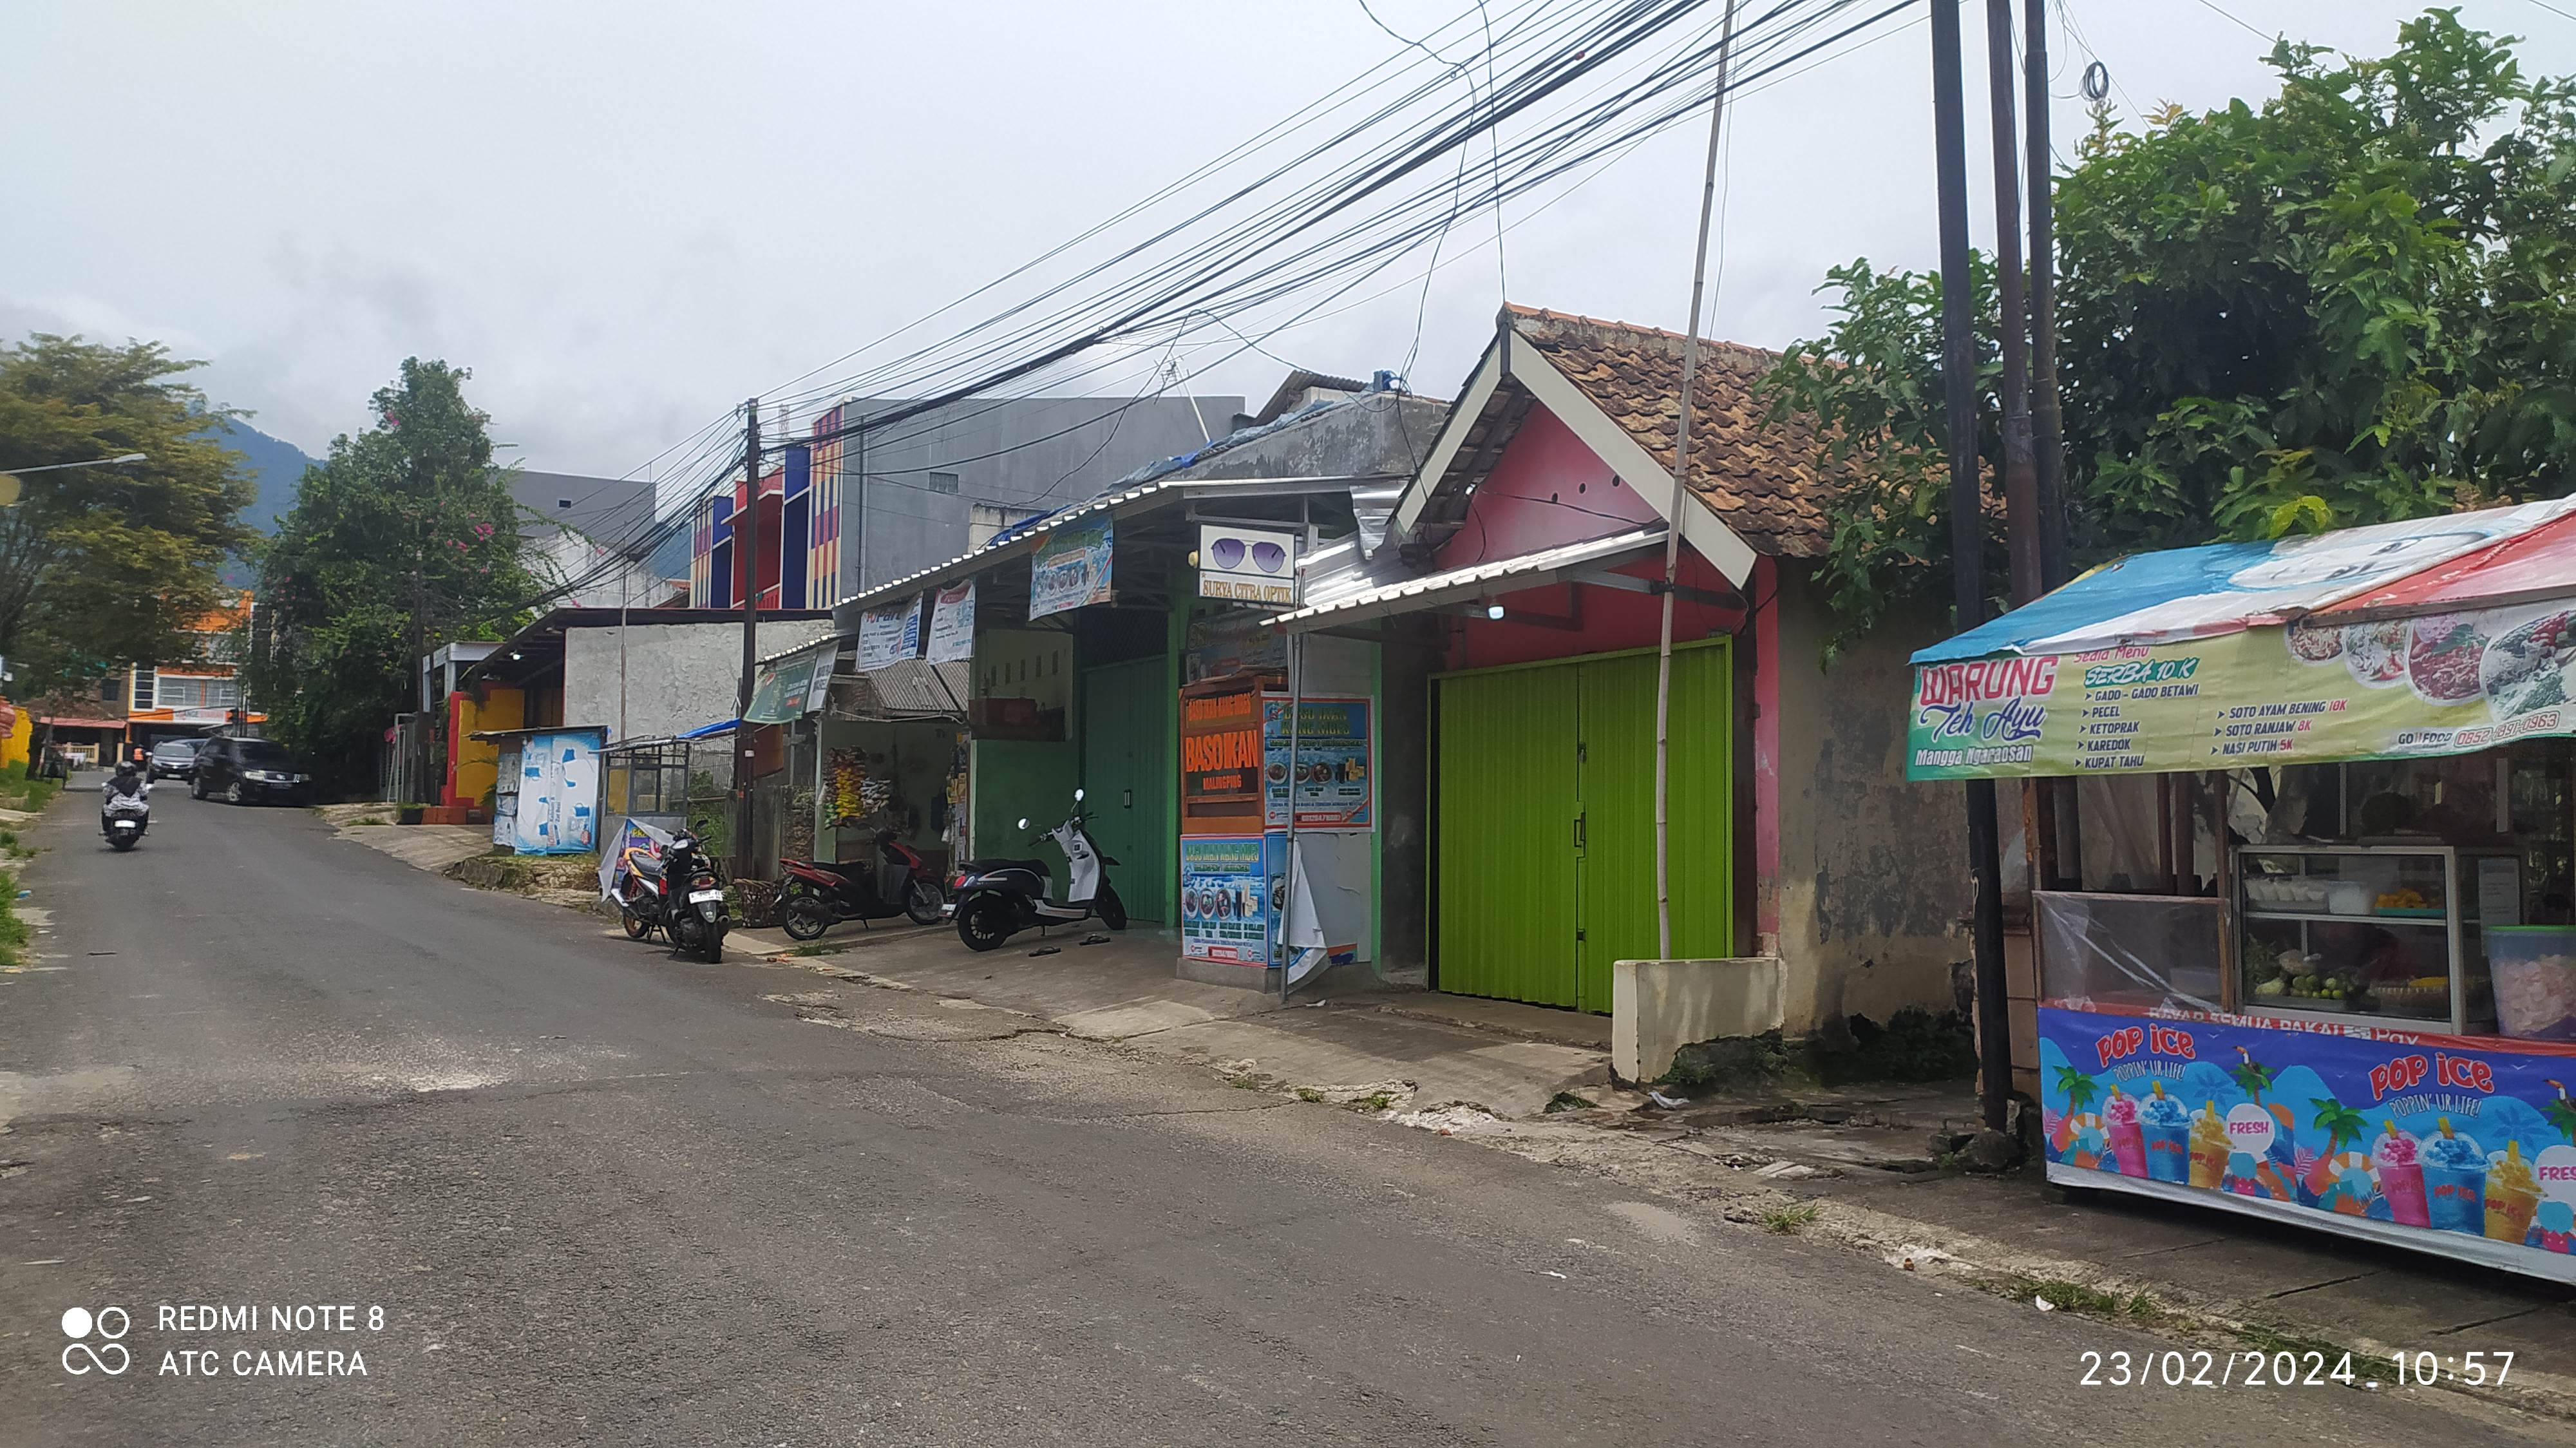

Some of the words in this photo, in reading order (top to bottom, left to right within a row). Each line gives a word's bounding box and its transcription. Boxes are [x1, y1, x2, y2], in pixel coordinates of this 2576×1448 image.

[1202, 580, 1233, 597] SURYA
[1234, 582, 1262, 600] CITRA
[1264, 586, 1292, 604] OPTIK
[2115, 646, 2150, 659] Menu
[2084, 659, 2155, 686] SERBA
[2154, 662, 2175, 681] 10
[2177, 658, 2197, 678] K
[1919, 656, 2060, 707] WARUNG
[2094, 690, 2121, 701] GADO
[2131, 687, 2159, 700] GADO
[2160, 683, 2199, 698] BETAWI
[1283, 707, 1314, 720] BSO
[1919, 701, 1975, 741] Teh
[1983, 696, 2046, 741] Ayu
[2091, 706, 2121, 718] PECEL
[2229, 706, 2257, 719] SOTO
[2258, 704, 2287, 717] AYAM
[2288, 701, 2327, 715] BENING
[1281, 721, 1314, 735] KNG
[2089, 721, 2141, 735] KETOPRAK
[2226, 723, 2253, 737] SOTO
[2254, 720, 2297, 735] RANJAW
[2297, 719, 2313, 732] 8K
[1185, 733, 1224, 772] BASO
[1224, 729, 1258, 769] IKAN
[2087, 739, 2131, 752] KAREDOK
[2222, 742, 2246, 755] NASI
[2246, 739, 2278, 753] PUTIH
[2279, 738, 2294, 751] 5K
[1915, 748, 1963, 767] Mangga
[2085, 757, 2116, 769] KUPAT
[2119, 755, 2145, 767] TAHU
[2229, 1121, 2269, 1135] FRESH
